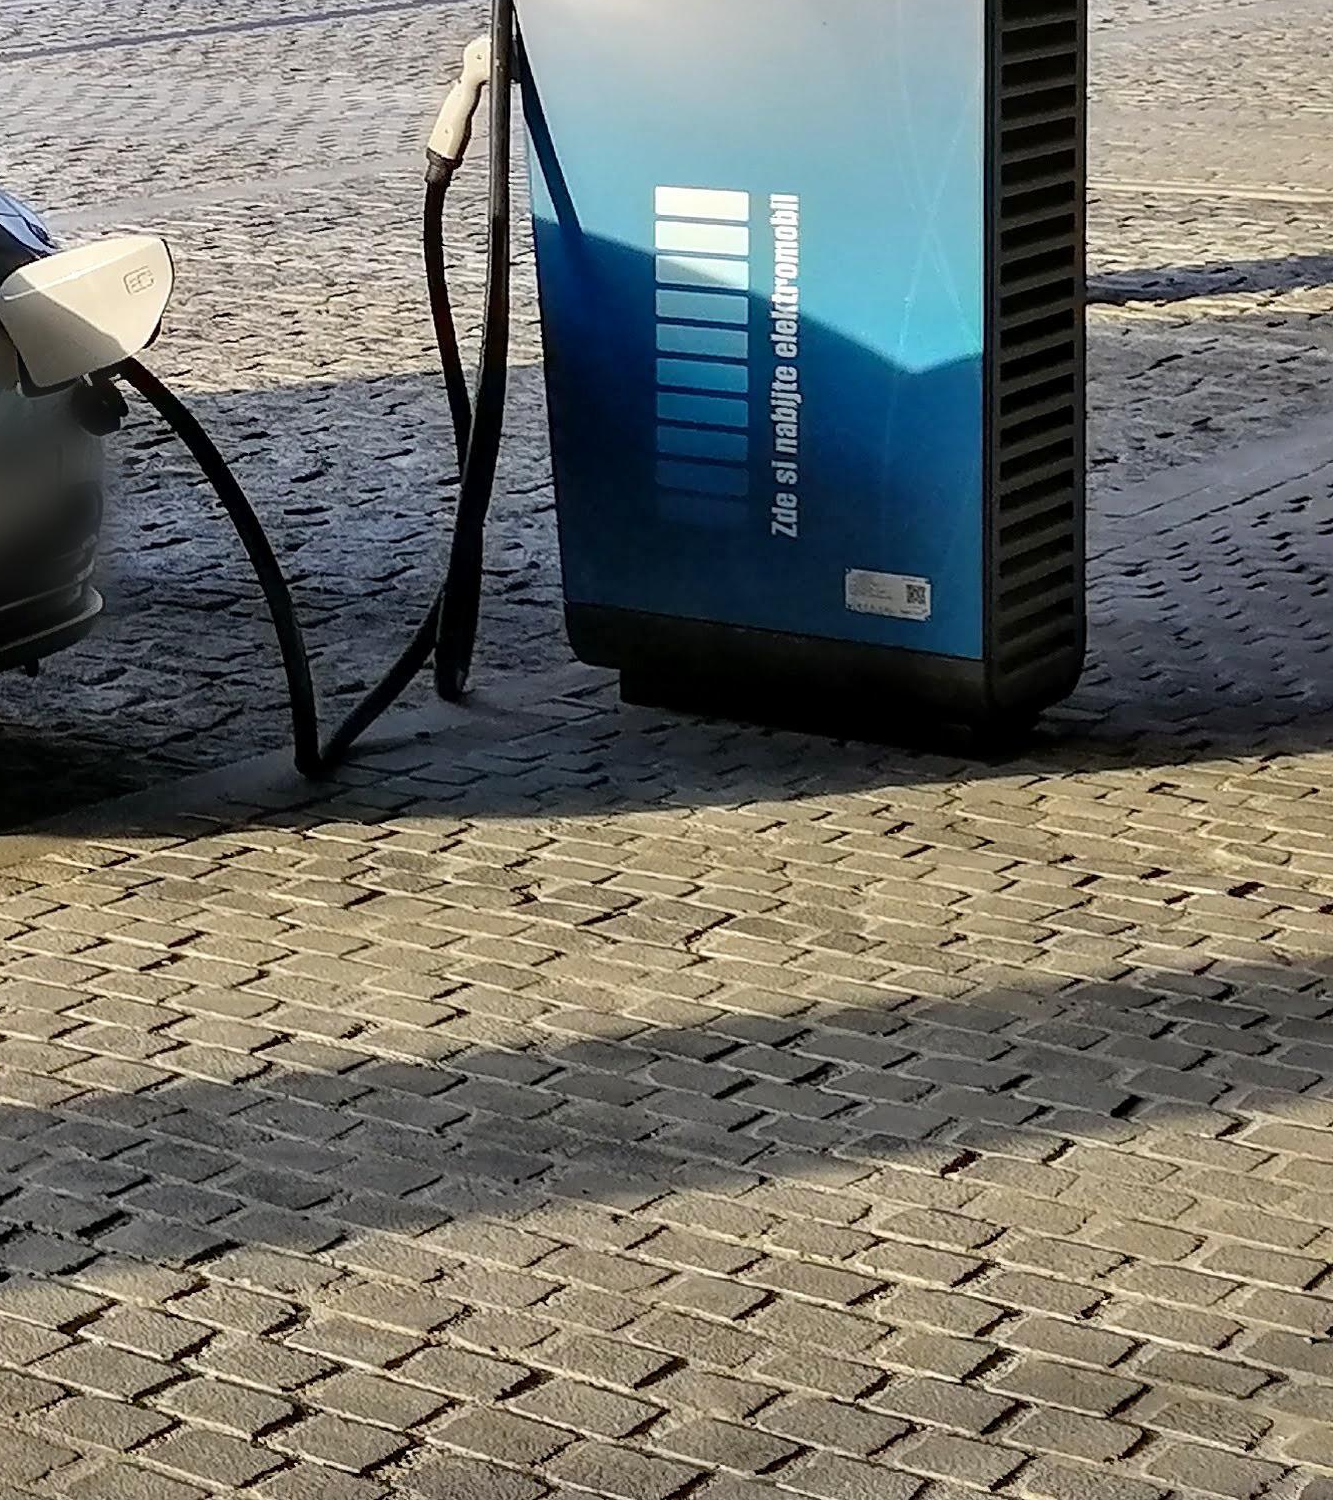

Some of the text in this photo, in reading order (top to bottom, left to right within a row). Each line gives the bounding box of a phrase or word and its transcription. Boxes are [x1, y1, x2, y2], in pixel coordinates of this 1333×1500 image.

[769, 194, 800, 358] elektromobil
[771, 460, 798, 485] si
[771, 492, 798, 539] Zde
